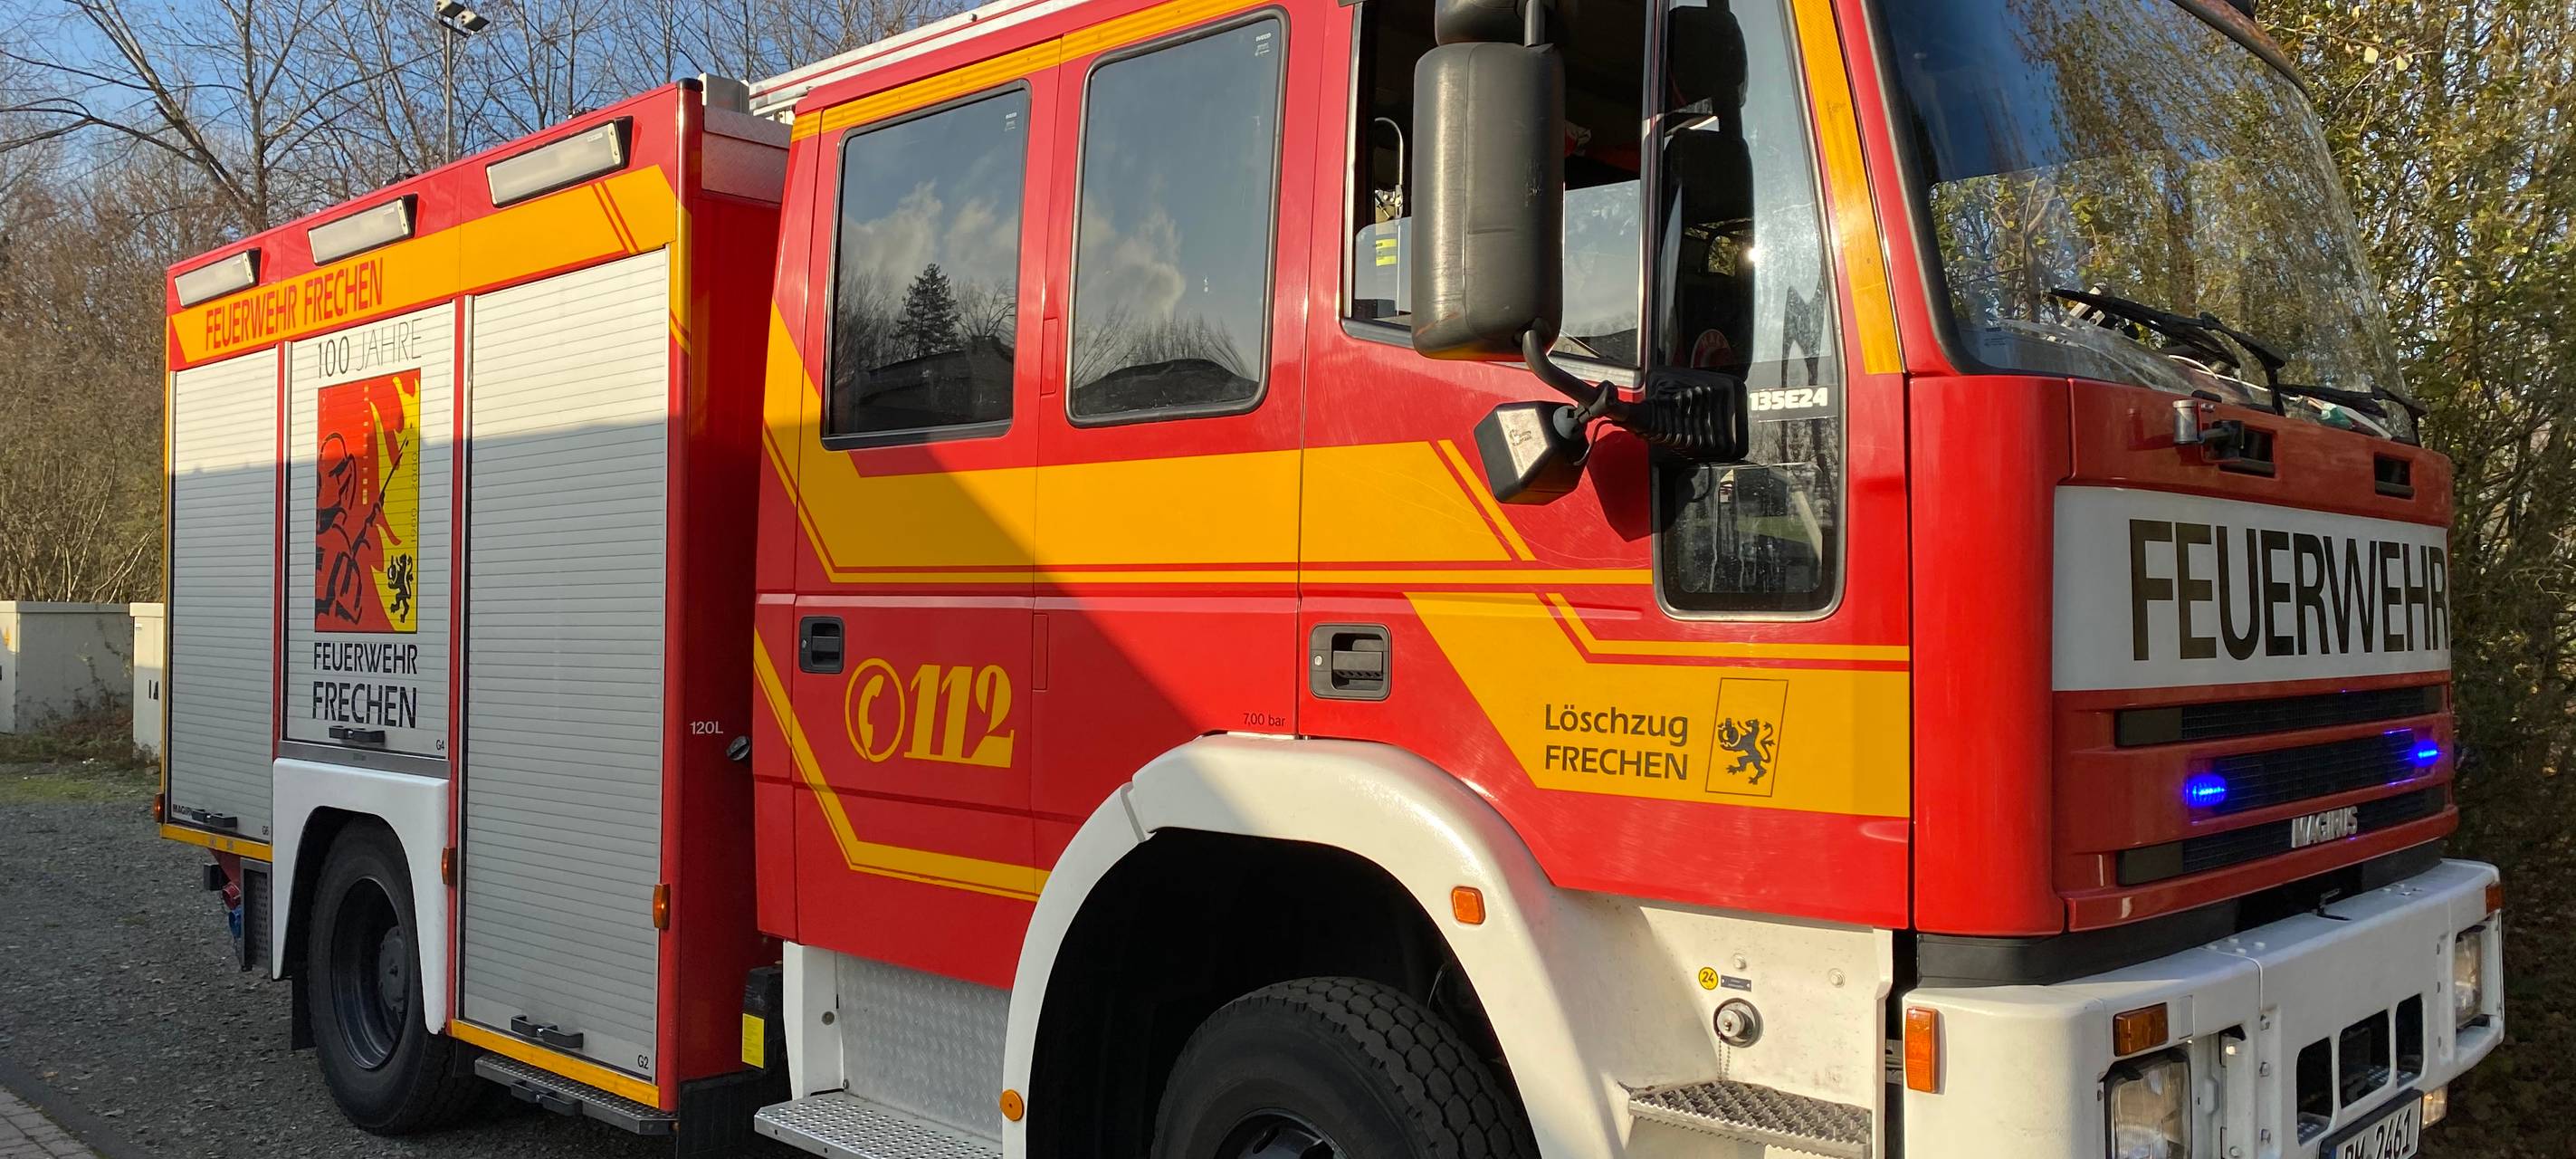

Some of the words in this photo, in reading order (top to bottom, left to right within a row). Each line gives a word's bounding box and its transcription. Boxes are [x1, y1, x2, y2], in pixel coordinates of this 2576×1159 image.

[205, 283, 298, 352] FEUERWEHR
[304, 256, 384, 326] FRECHEN
[318, 335, 349, 378] 100
[355, 318, 422, 371] JAHRE
[1749, 387, 1828, 411] 135E24
[2129, 518, 2450, 662] FEUERWEHR
[313, 642, 418, 675] FEUERWEHR
[312, 681, 417, 729] FRECHEN
[903, 664, 1015, 769] 112
[1268, 714, 1286, 727] bar
[689, 720, 724, 735] 120L
[1544, 704, 1689, 747] Löschzug
[435, 739, 445, 752] G4
[1544, 744, 1689, 781] FRECHEN
[1702, 971, 1715, 983] 24
[637, 1054, 649, 1070] G2
[2376, 1107, 2411, 1159] 2461
